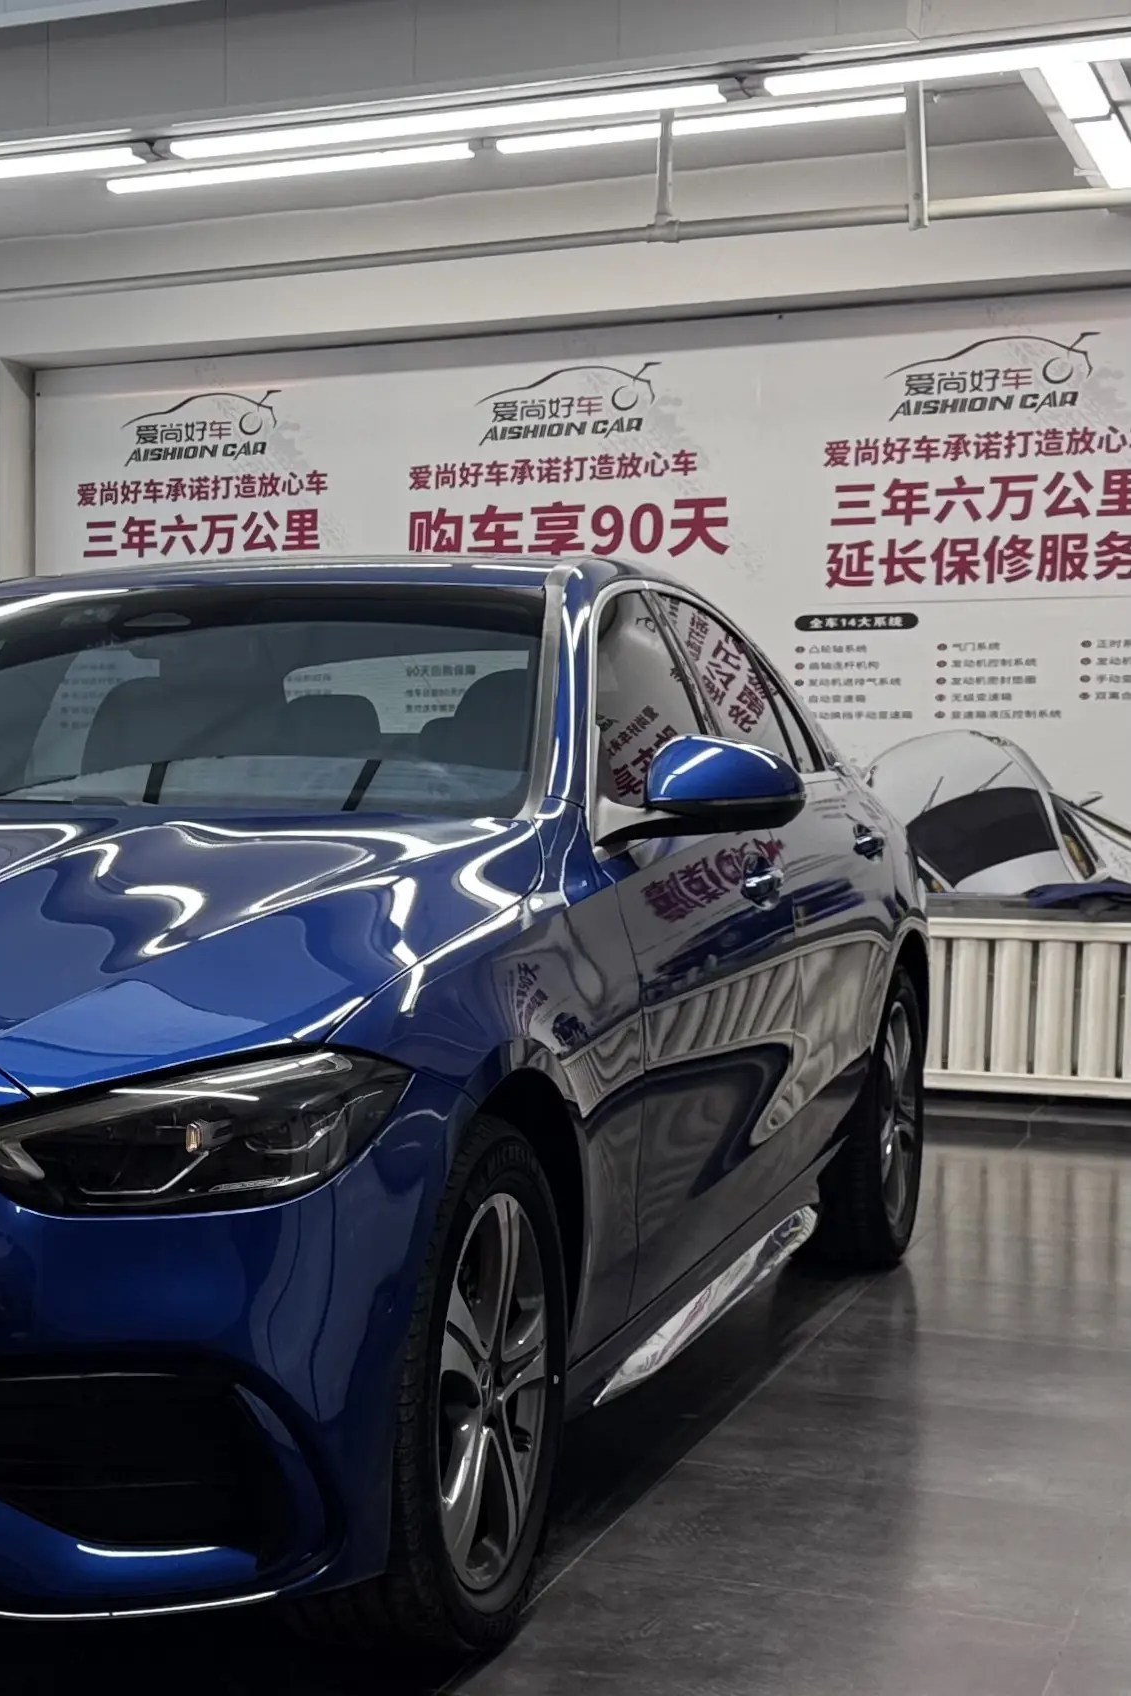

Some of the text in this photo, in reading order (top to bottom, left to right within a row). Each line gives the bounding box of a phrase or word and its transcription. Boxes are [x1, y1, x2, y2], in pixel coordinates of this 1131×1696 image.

[904, 368, 1033, 396] 爱尚好车
[492, 396, 603, 423] 爱尚好车
[888, 391, 1079, 421] AISHION CAR
[135, 420, 232, 445] 爱尚好车
[478, 417, 644, 446] AISHION CAR
[823, 425, 1131, 468] 爱尚好车承诺打造放心
[124, 441, 268, 467] AISHION CAR
[408, 449, 698, 491] 爱尚好车承诺打造放心车
[77, 469, 329, 507] 爱尚好车承诺打造放心车
[830, 467, 1131, 527] 三年六万公里
[83, 508, 321, 559] 三年六万公里
[408, 496, 731, 558] 购车享90天
[825, 530, 1131, 589] 延长保修服务
